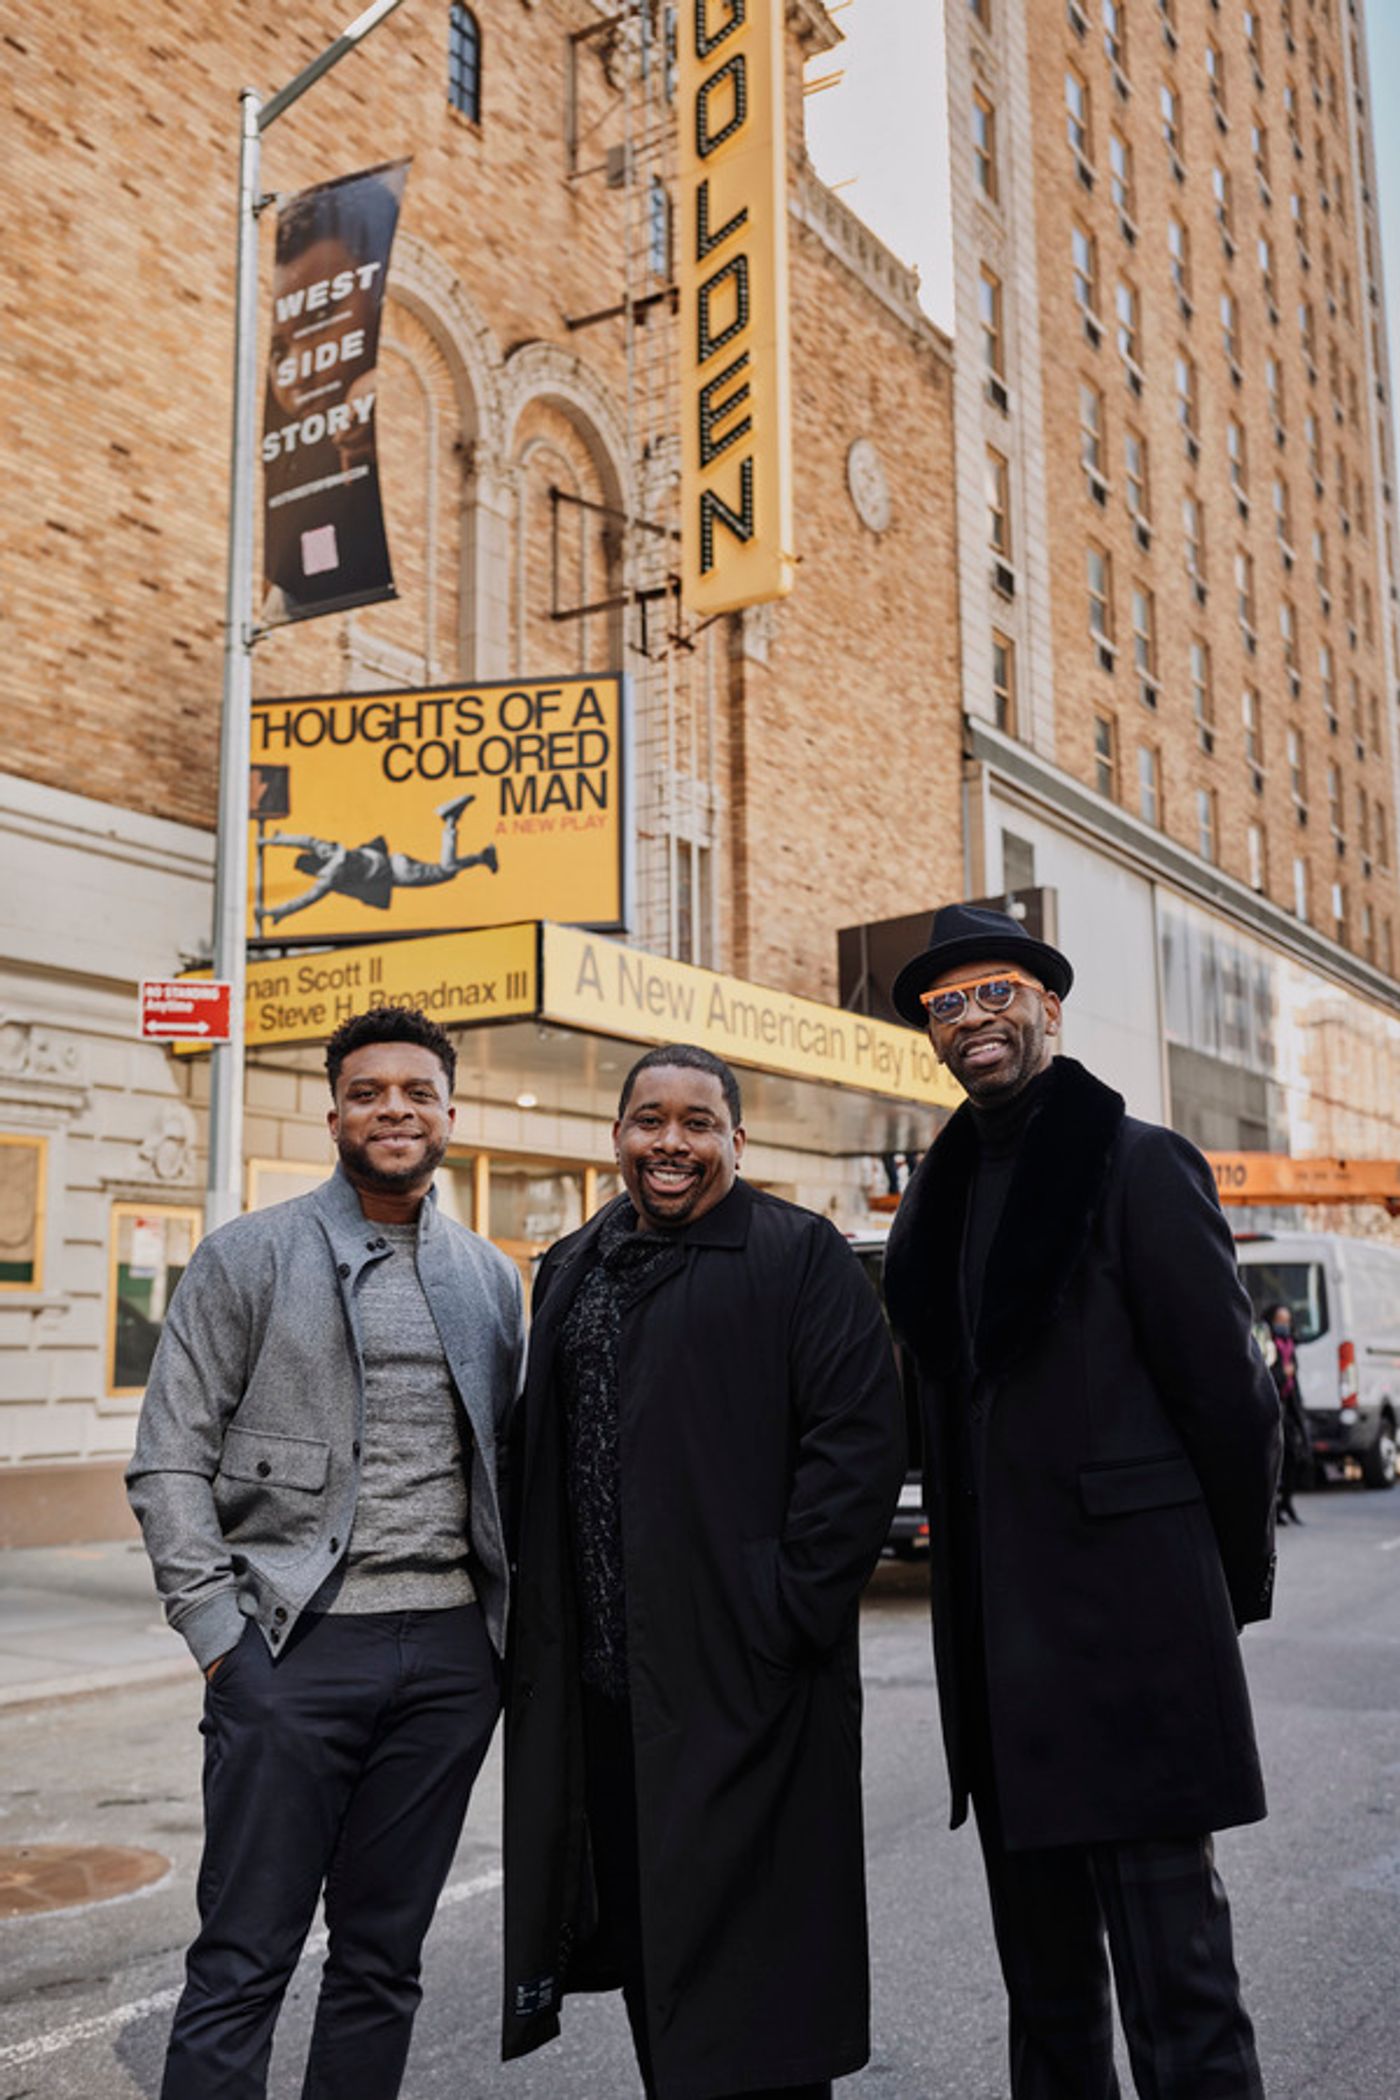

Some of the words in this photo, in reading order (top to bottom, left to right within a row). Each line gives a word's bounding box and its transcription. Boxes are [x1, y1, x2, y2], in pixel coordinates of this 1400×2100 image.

[276, 261, 381, 323] WEST
[276, 328, 366, 388] SIDE
[263, 393, 375, 463] STORY
[499, 690, 562, 732] OF
[572, 687, 606, 727] A
[382, 729, 610, 783] COLORED
[500, 769, 607, 816] MAN
[495, 820, 507, 835] A
[513, 817, 555, 834] NEW
[561, 813, 608, 832] PLAY
[260, 1001, 327, 1031] Steve
[369, 981, 497, 1014] Broadnax
[506, 970, 527, 1000] III
[297, 964, 362, 995] Scott
[370, 956, 382, 983] II
[575, 944, 605, 1002] A
[618, 952, 695, 1023] New
[706, 981, 846, 1063] American
[855, 1023, 904, 1089] Play
